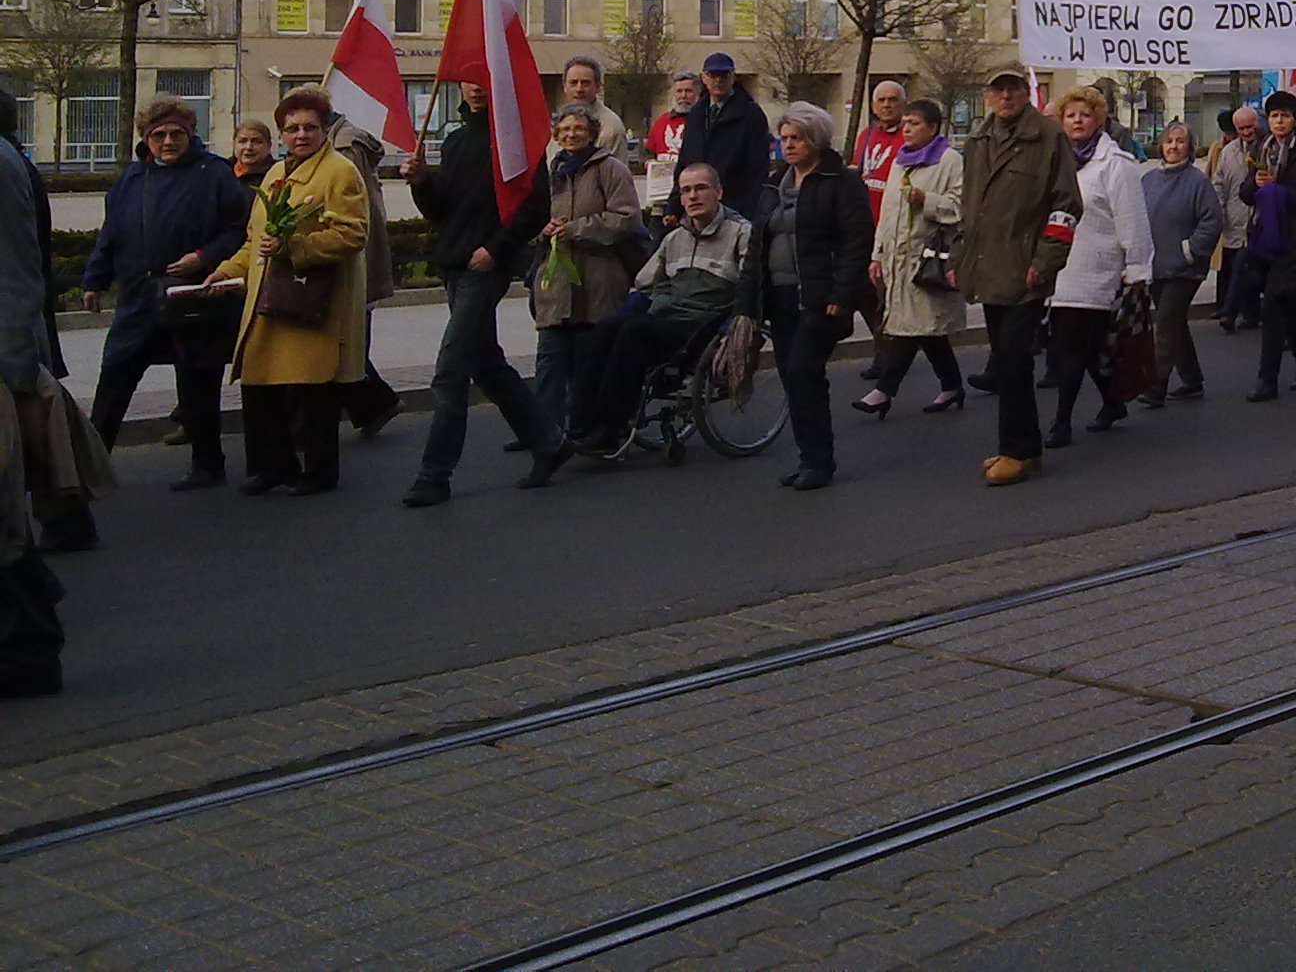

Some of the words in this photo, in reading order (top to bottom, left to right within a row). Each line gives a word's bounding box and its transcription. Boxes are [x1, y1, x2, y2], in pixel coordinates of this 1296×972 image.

[1034, 1, 1141, 33] NAJPIERW
[1158, 4, 1194, 32] GO
[1102, 38, 1191, 65] POLSCE
